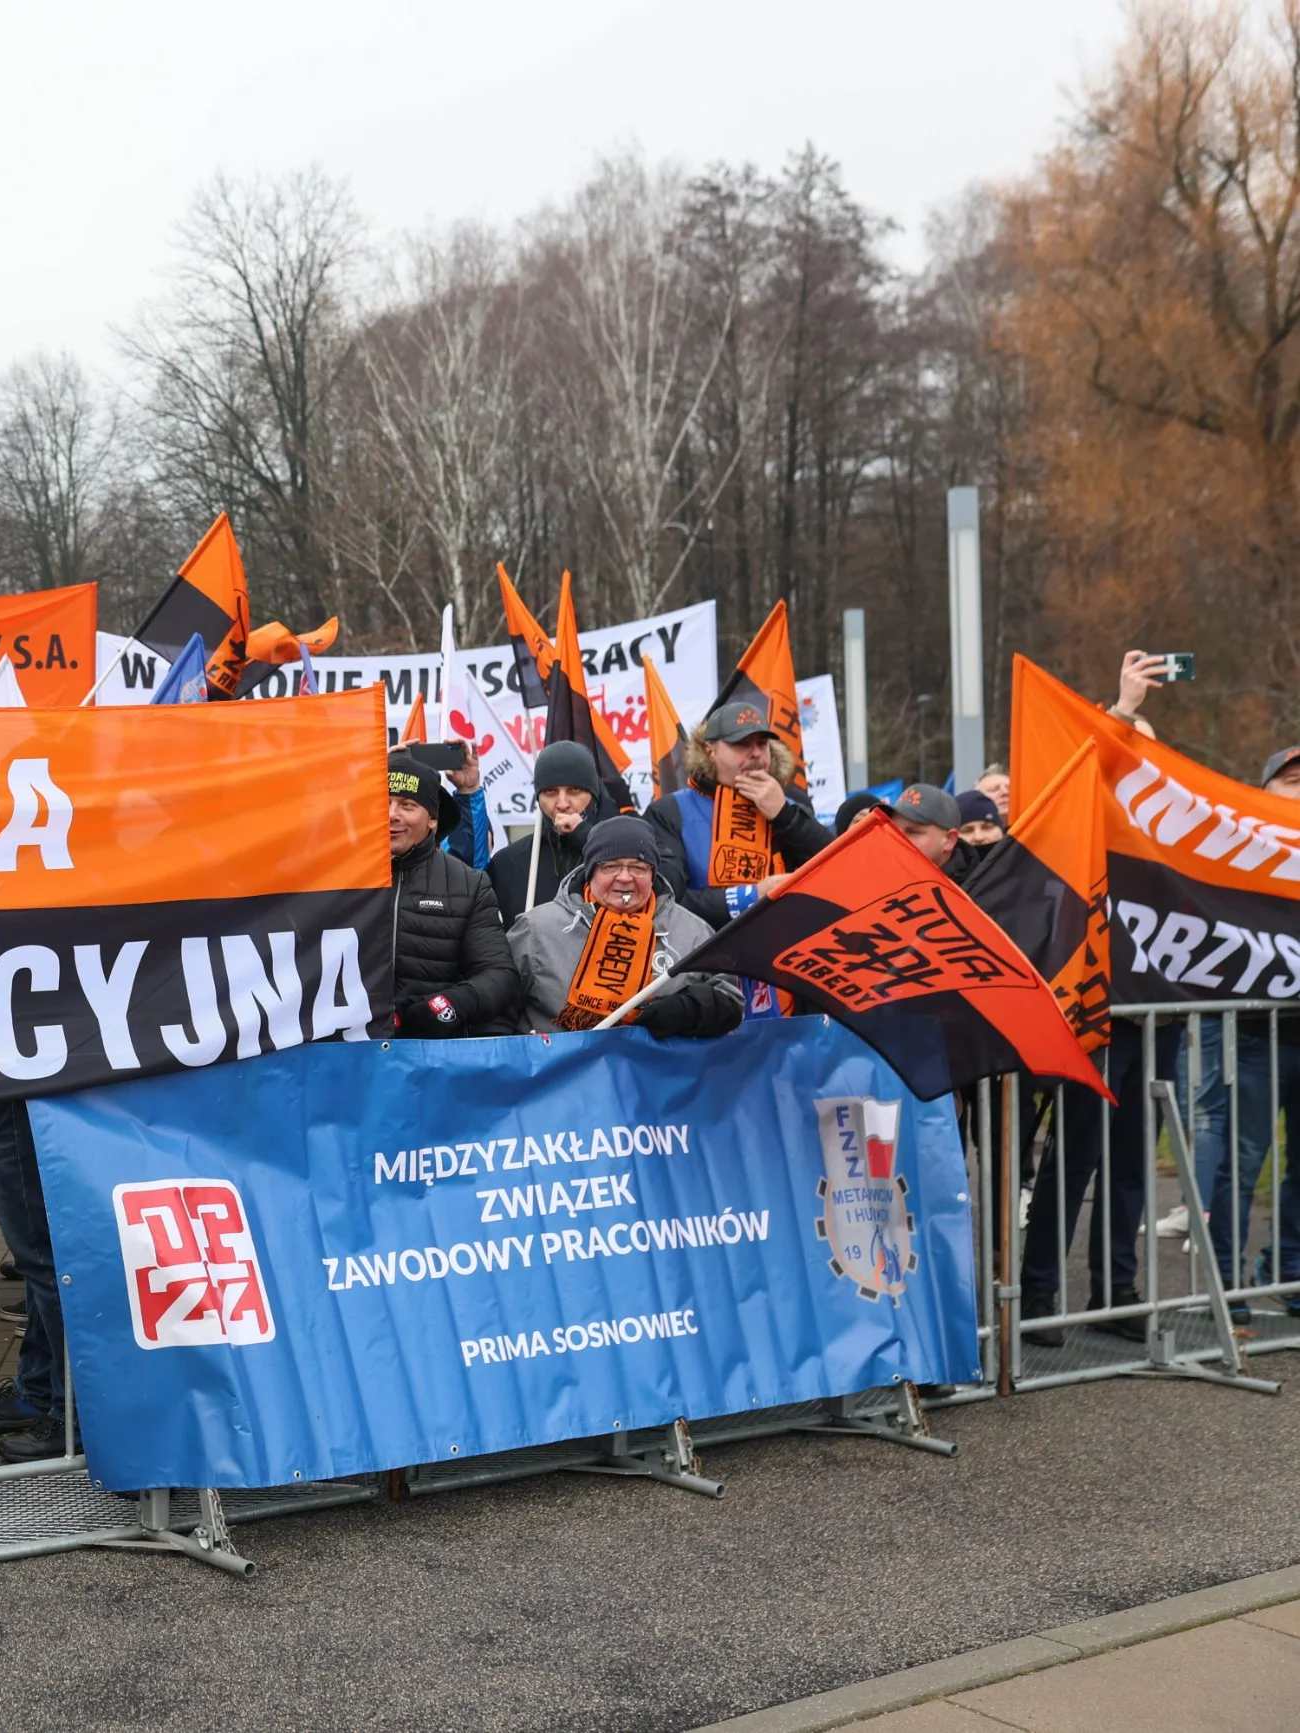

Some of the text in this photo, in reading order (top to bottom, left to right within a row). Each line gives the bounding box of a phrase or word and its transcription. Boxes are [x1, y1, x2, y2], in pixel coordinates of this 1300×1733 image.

[13, 633, 79, 671] S.A.
[576, 993, 604, 1010] SINCE
[373, 1124, 690, 1187] MIĘDZYZAKŁADOWY
[476, 1173, 636, 1223] ZWIĄZEK
[321, 1207, 770, 1291] ZAWODOWY PRACOWNIKÓW
[460, 1308, 699, 1368] PRIMA SOSNOWIEC
